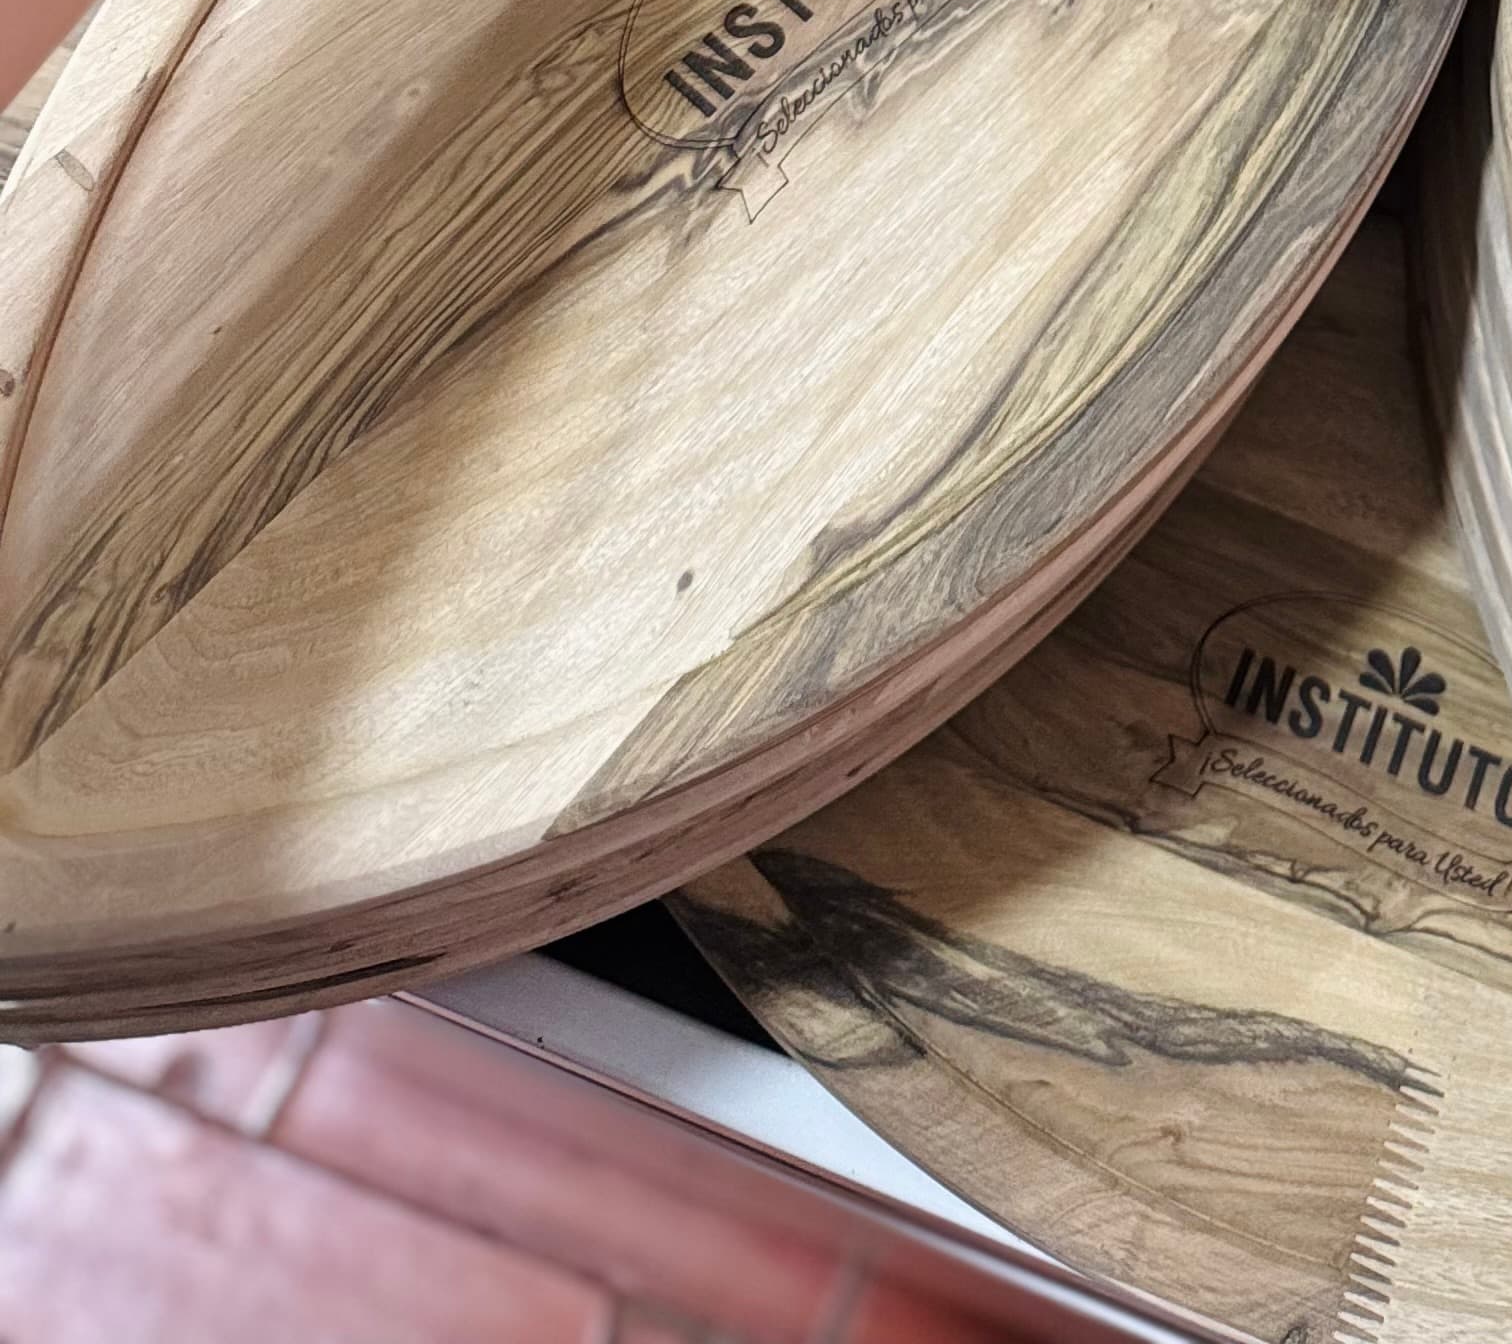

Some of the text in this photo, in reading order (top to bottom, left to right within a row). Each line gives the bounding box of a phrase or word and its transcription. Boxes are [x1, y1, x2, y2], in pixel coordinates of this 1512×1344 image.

[750, 5, 904, 170] ¡Seleccionados
[1201, 749, 1380, 838] ¡Seleccionados
[1370, 828, 1430, 868] para
